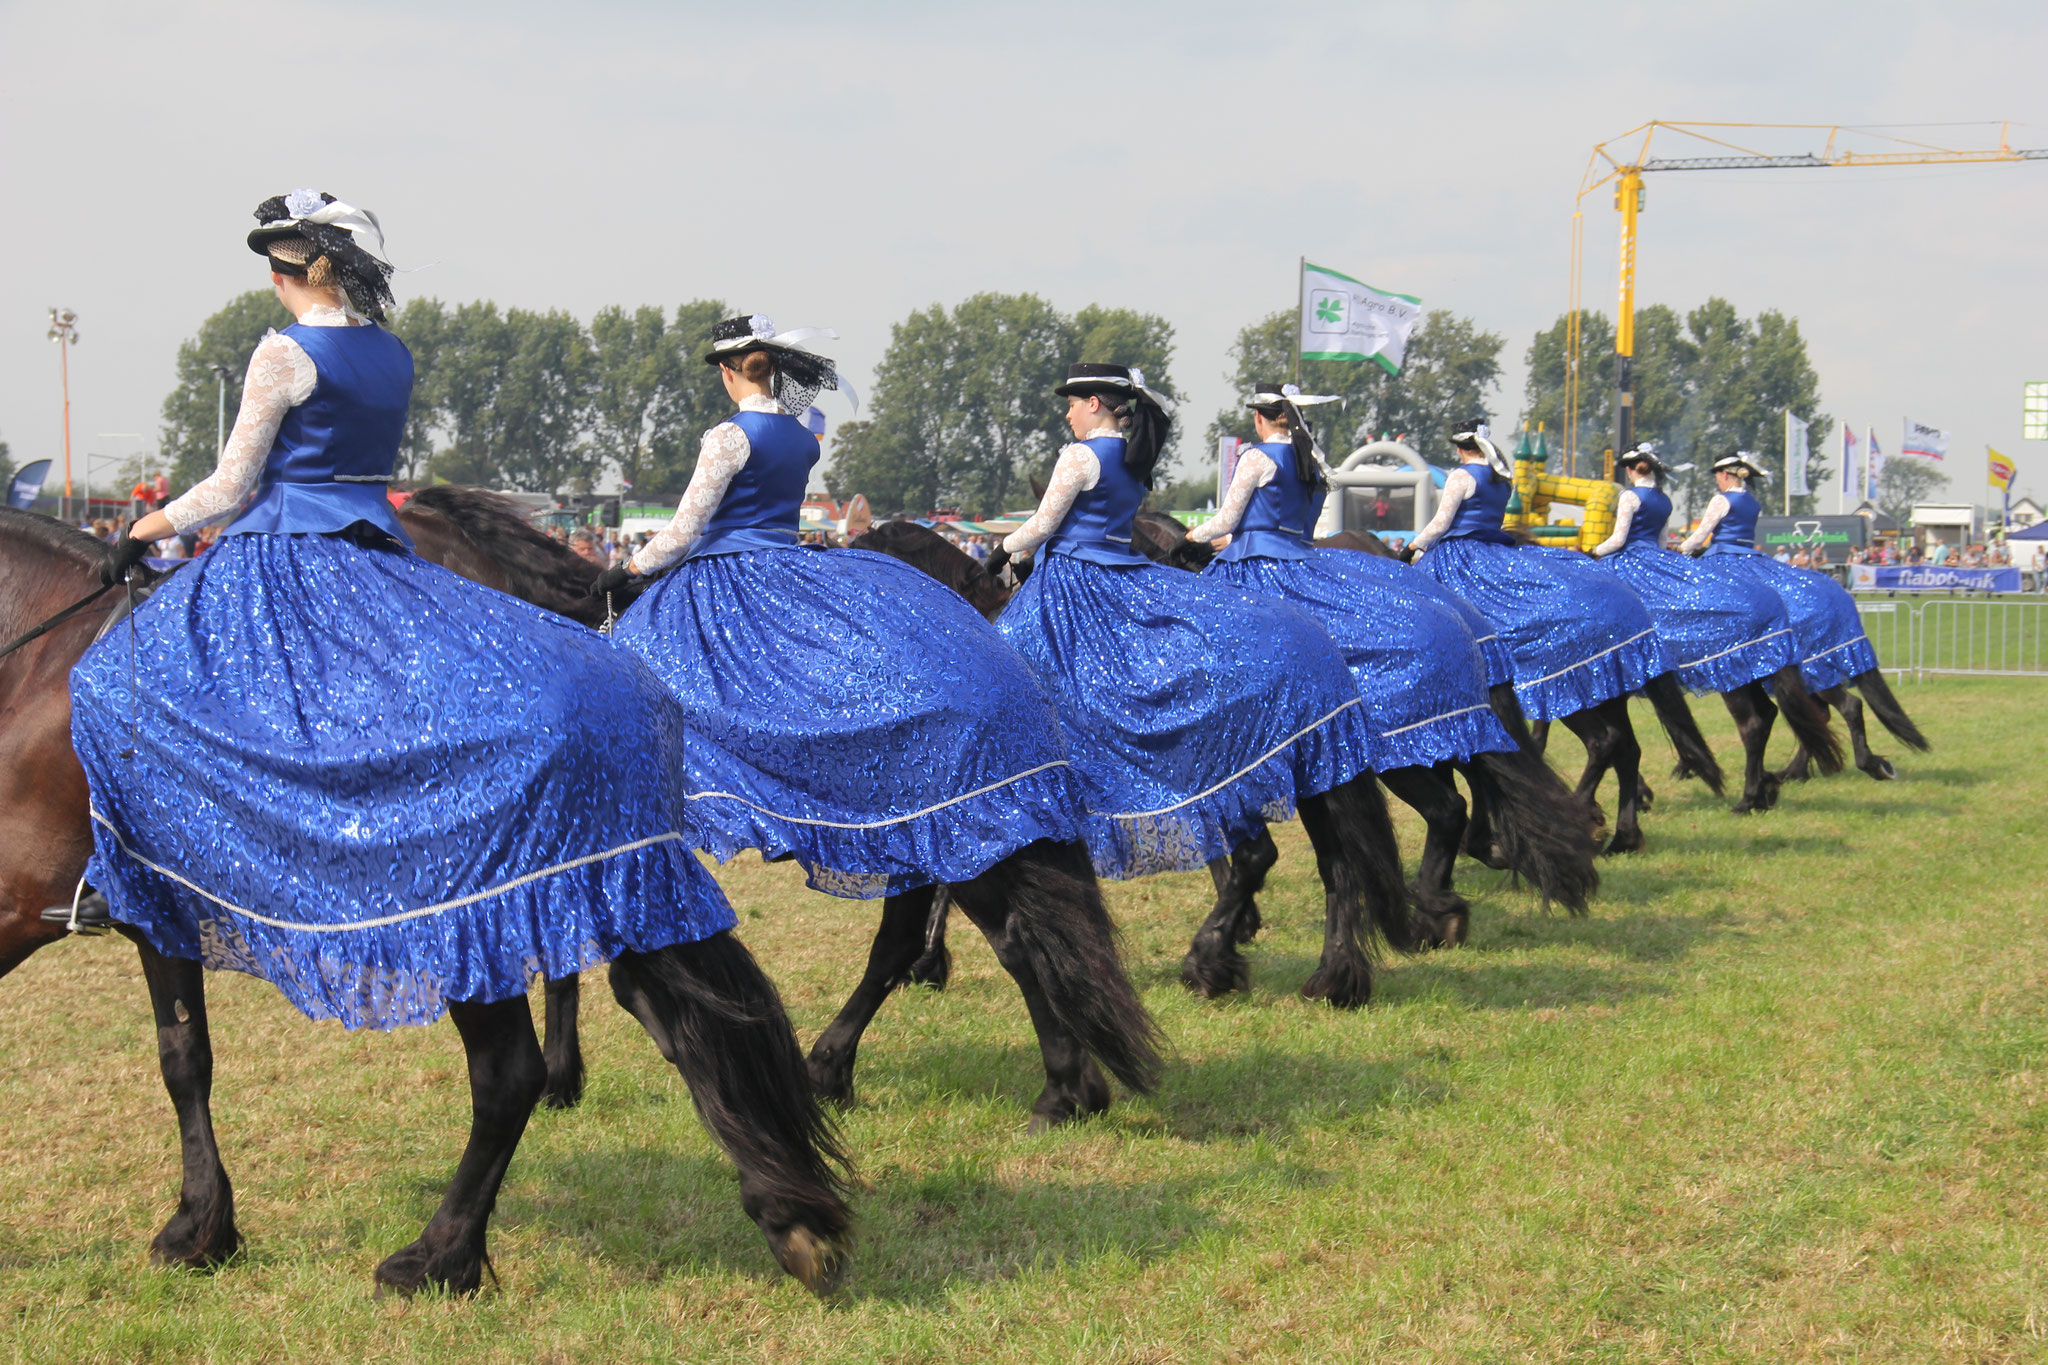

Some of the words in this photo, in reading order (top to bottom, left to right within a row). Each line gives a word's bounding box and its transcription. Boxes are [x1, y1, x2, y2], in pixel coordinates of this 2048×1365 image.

[1361, 296, 1385, 311] Agro
[1388, 305, 1408, 320] B.V.
[1898, 567, 1996, 589] Rabobank
